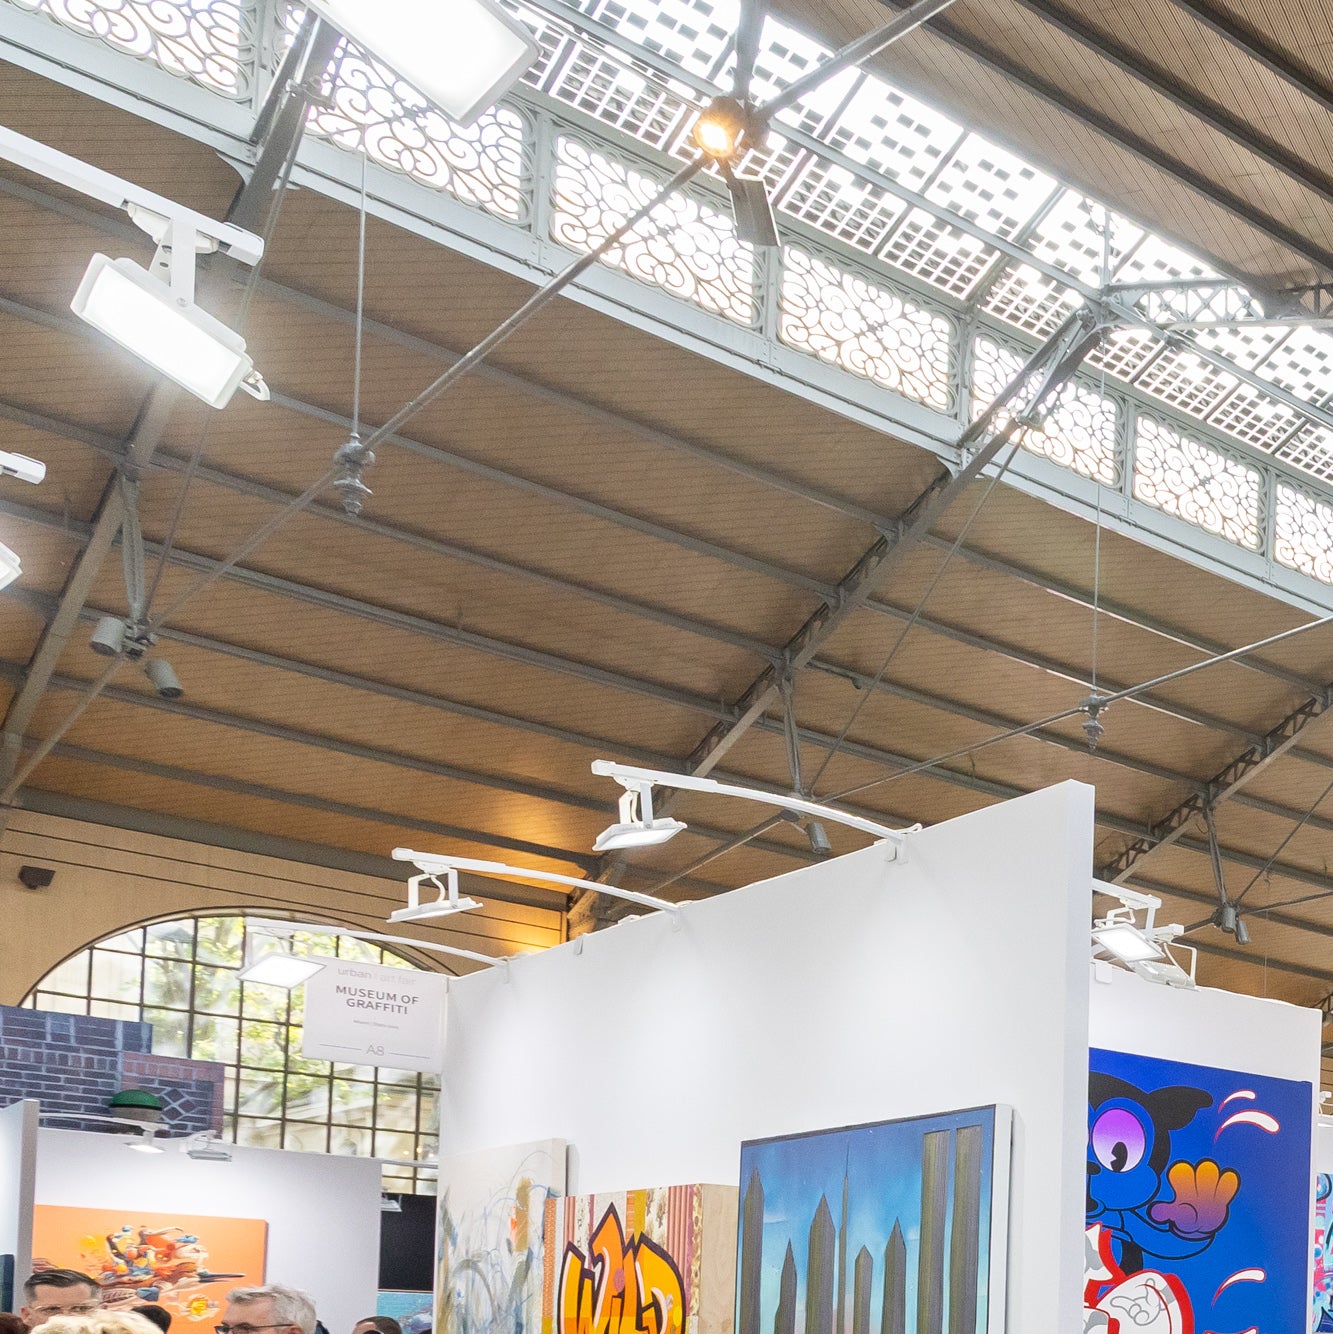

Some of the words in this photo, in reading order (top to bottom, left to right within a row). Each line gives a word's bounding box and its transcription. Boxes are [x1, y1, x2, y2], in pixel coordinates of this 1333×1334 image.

[337, 967, 372, 979] urban
[335, 985, 397, 1002] MUSEUM
[401, 995, 419, 1005] OF
[346, 998, 408, 1015] GRAFFITI
[366, 1045, 385, 1057] A8
